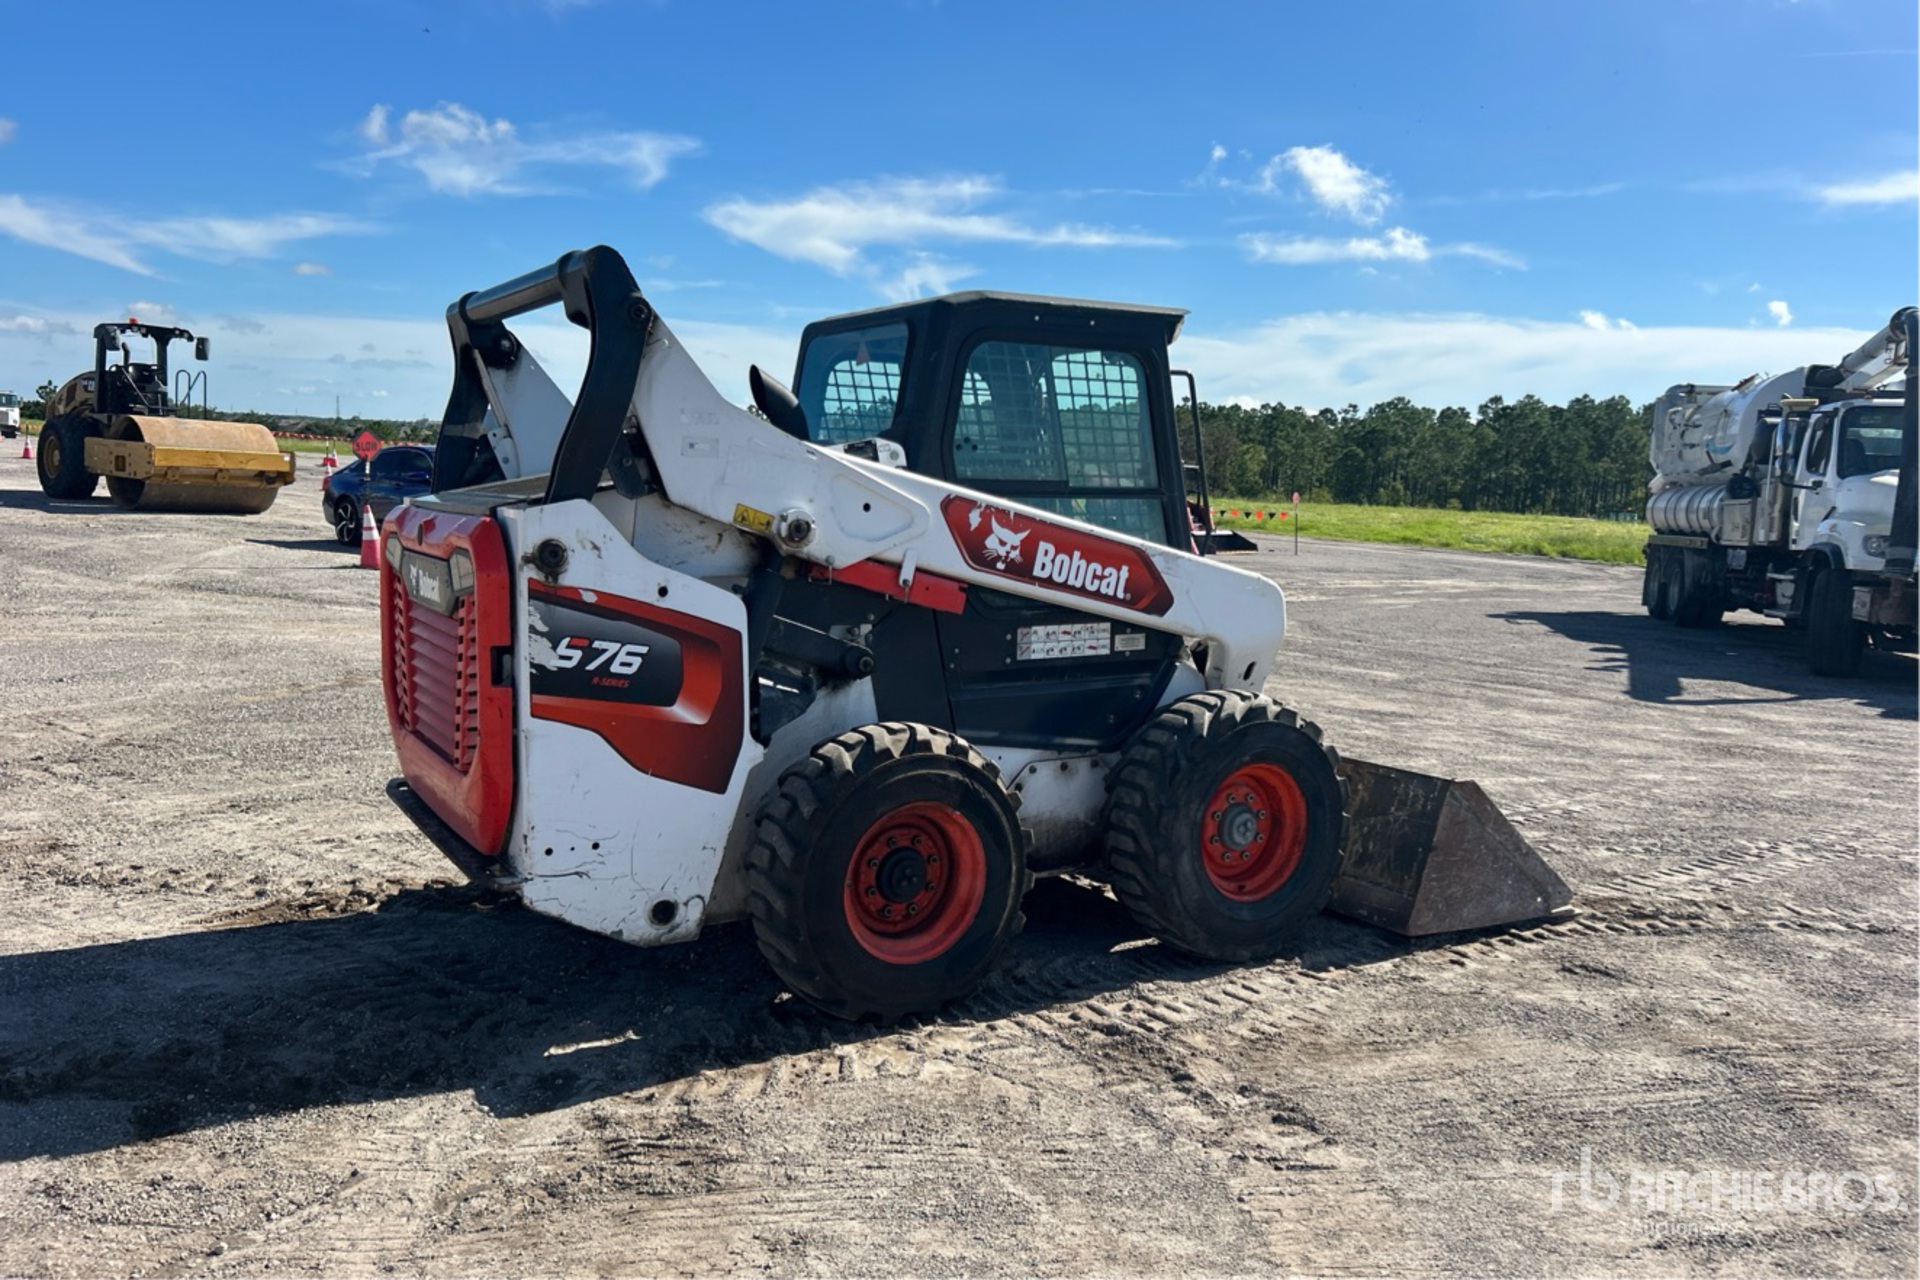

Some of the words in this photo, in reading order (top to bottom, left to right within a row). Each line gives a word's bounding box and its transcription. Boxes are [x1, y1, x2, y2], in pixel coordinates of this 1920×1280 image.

[354, 441, 378, 451] SLOW
[1032, 540, 1129, 600] Bobcat
[552, 636, 650, 675] S76
